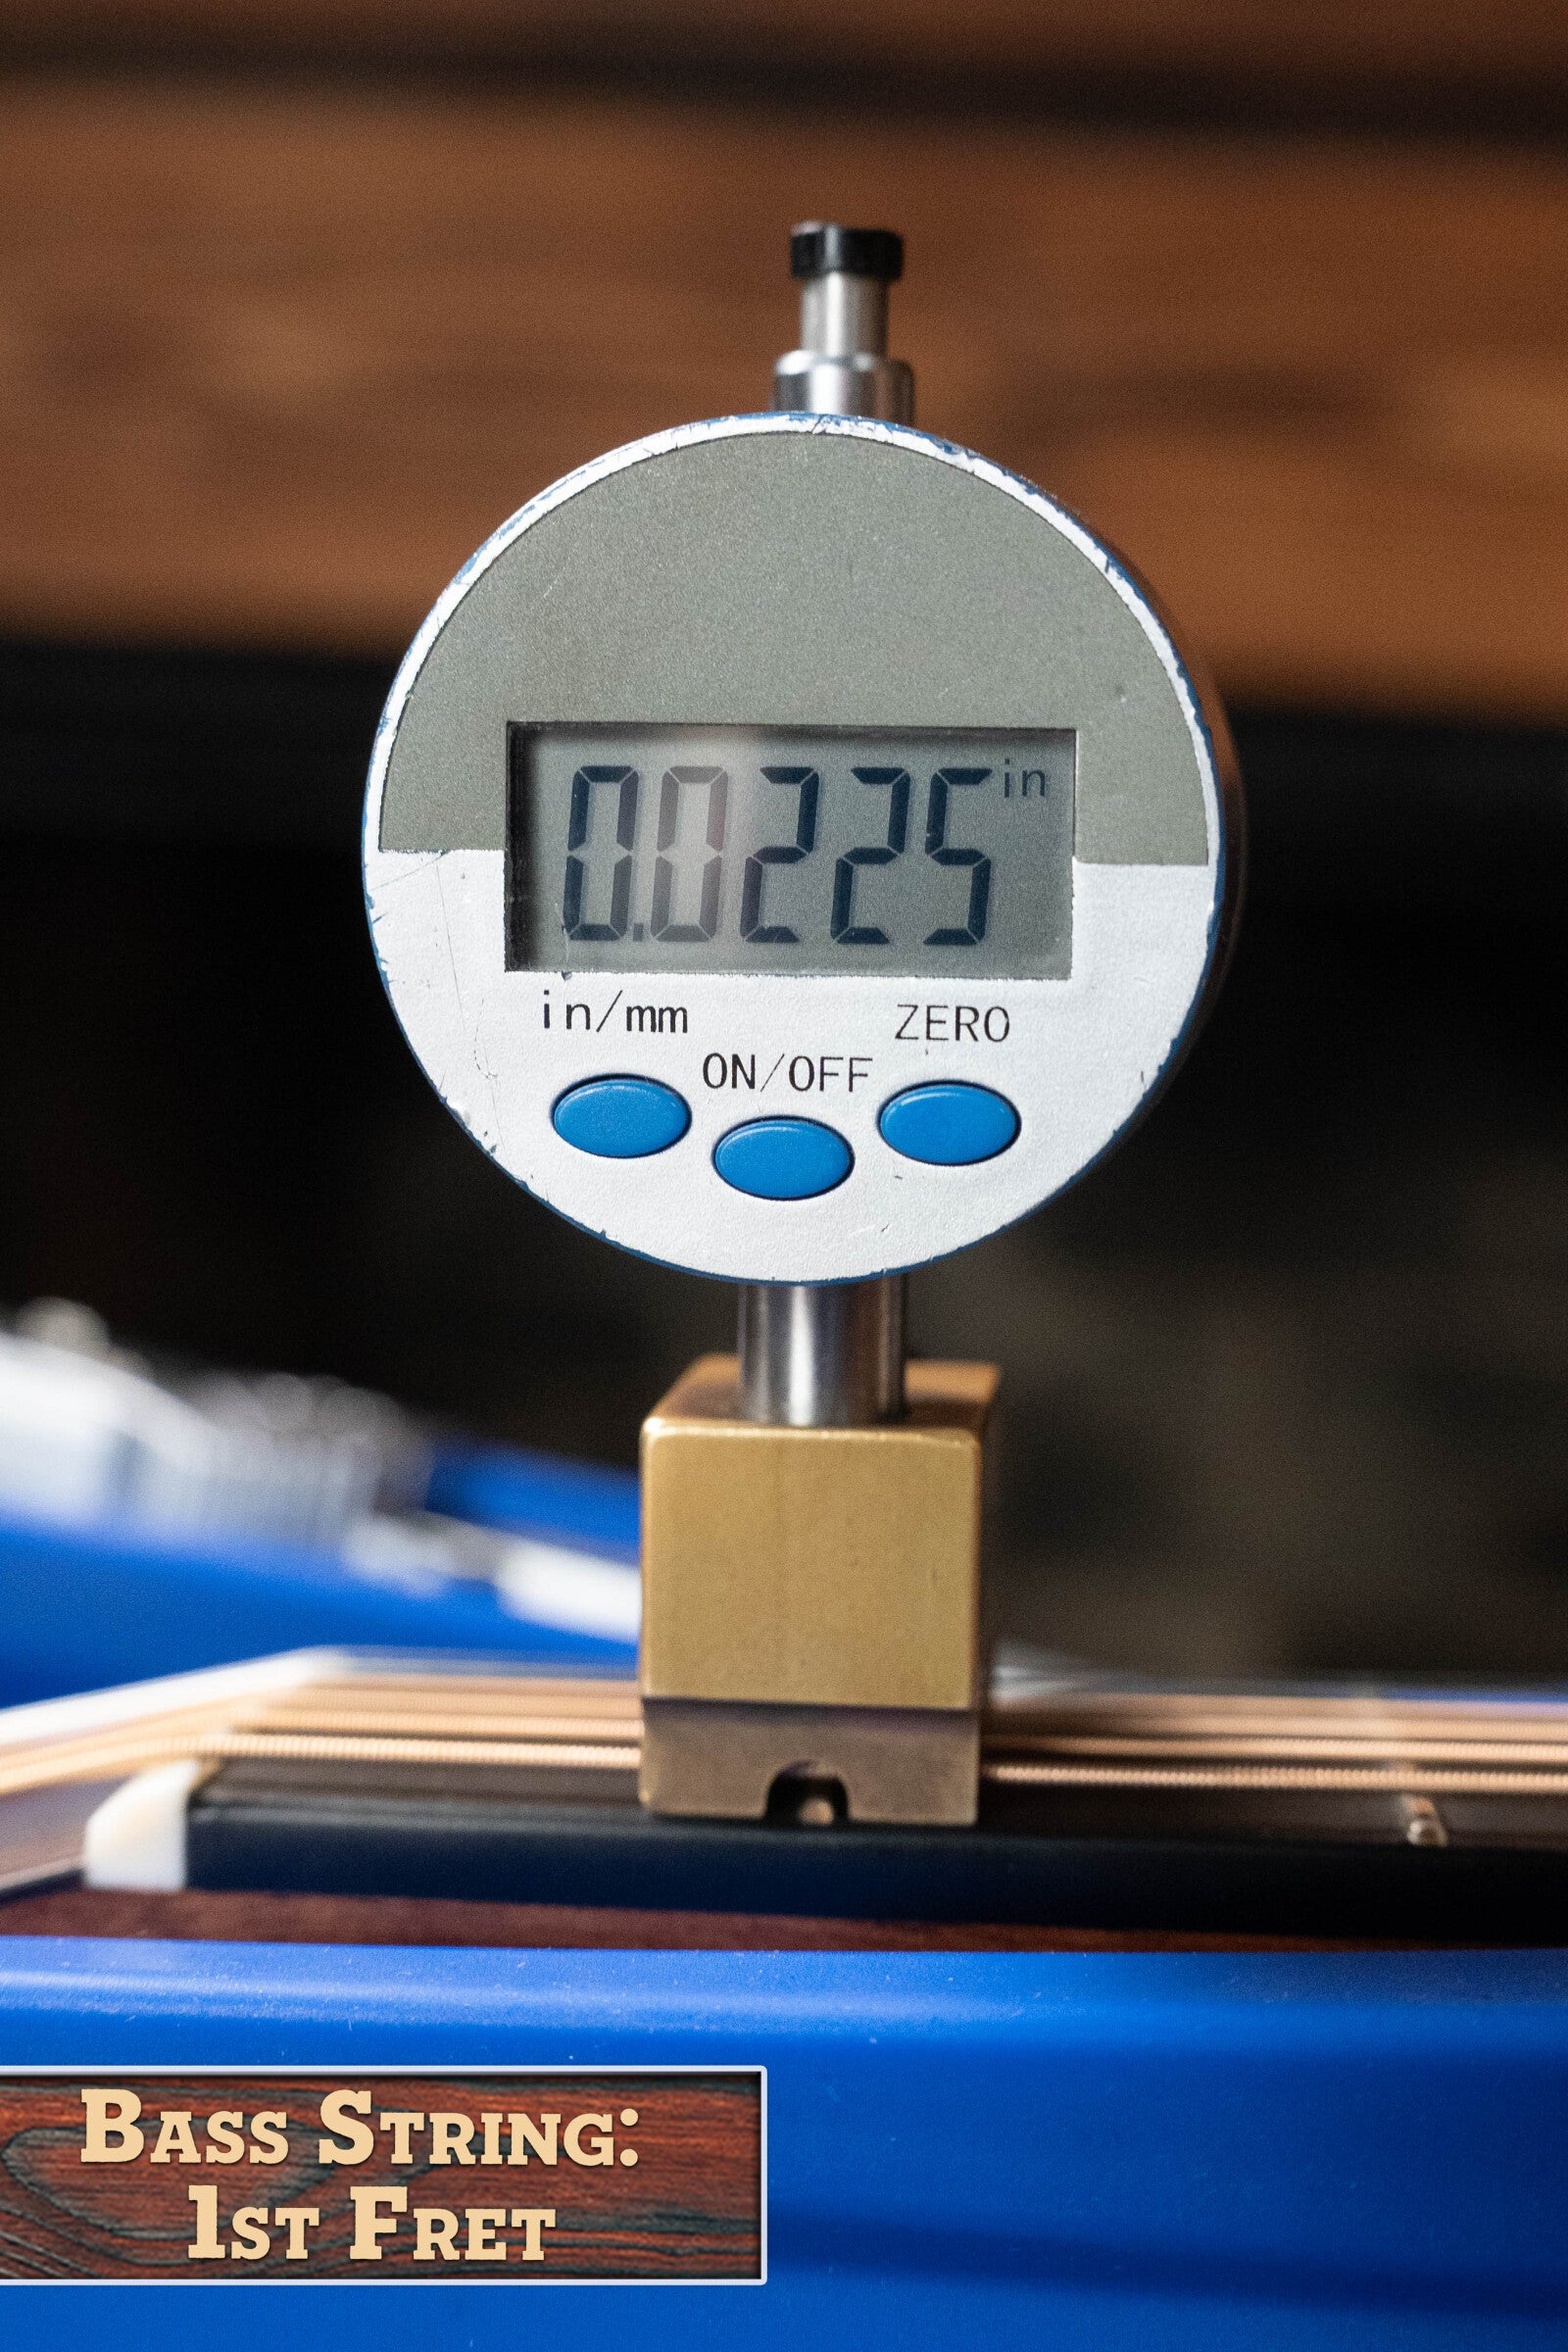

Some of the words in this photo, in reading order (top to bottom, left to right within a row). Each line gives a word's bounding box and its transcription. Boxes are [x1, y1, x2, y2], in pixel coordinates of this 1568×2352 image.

[564, 765, 992, 946] 0.0225
[1003, 759, 1047, 799] in
[542, 990, 688, 1034] in/mm
[894, 1004, 1011, 1043] ZERO
[702, 1053, 873, 1093] ON/OFF
